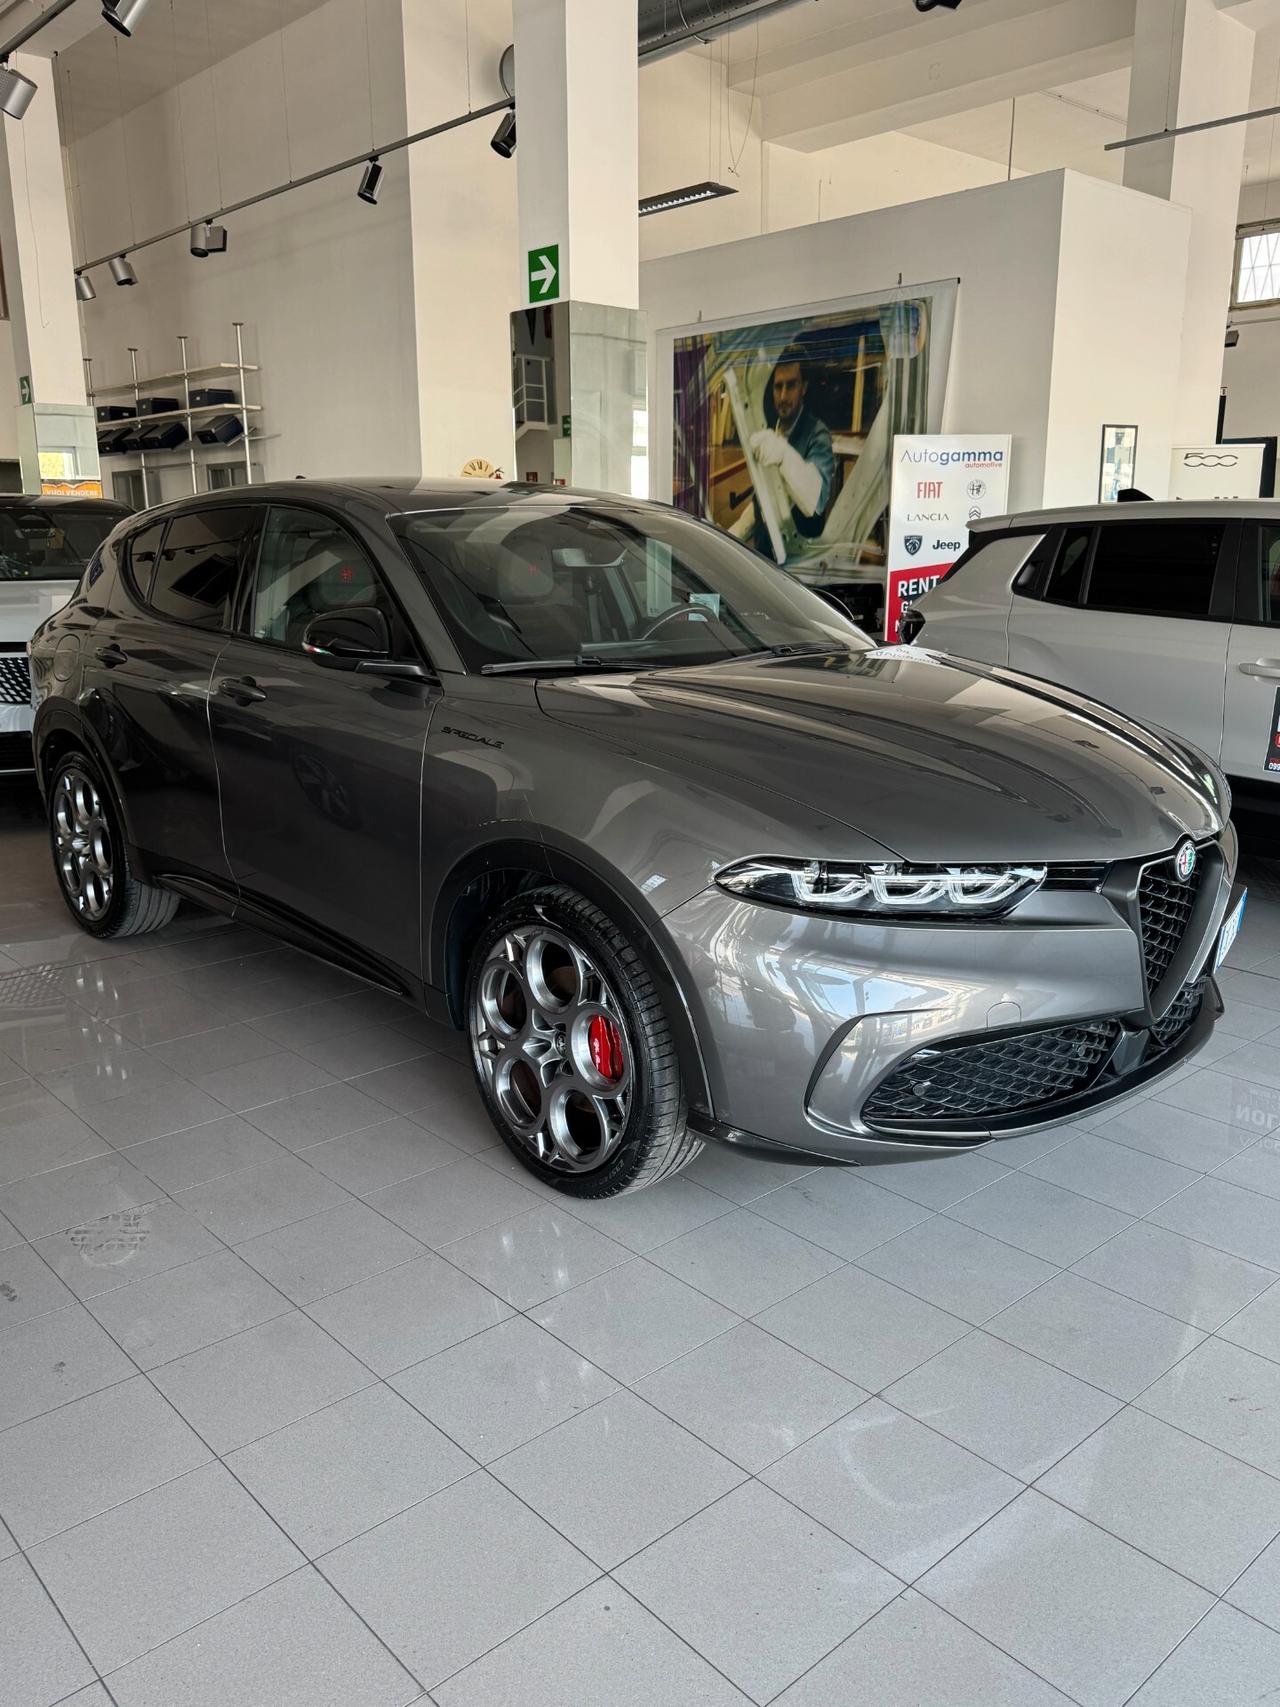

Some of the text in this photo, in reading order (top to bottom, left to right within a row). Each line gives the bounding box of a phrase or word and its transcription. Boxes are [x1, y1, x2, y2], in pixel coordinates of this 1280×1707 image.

[901, 449, 1003, 465] Autogamma
[964, 461, 1003, 469] automotive
[916, 481, 944, 499] FIAT
[906, 513, 950, 522] LANCIA
[932, 540, 961, 552] Jeep
[897, 575, 940, 597] RENT
